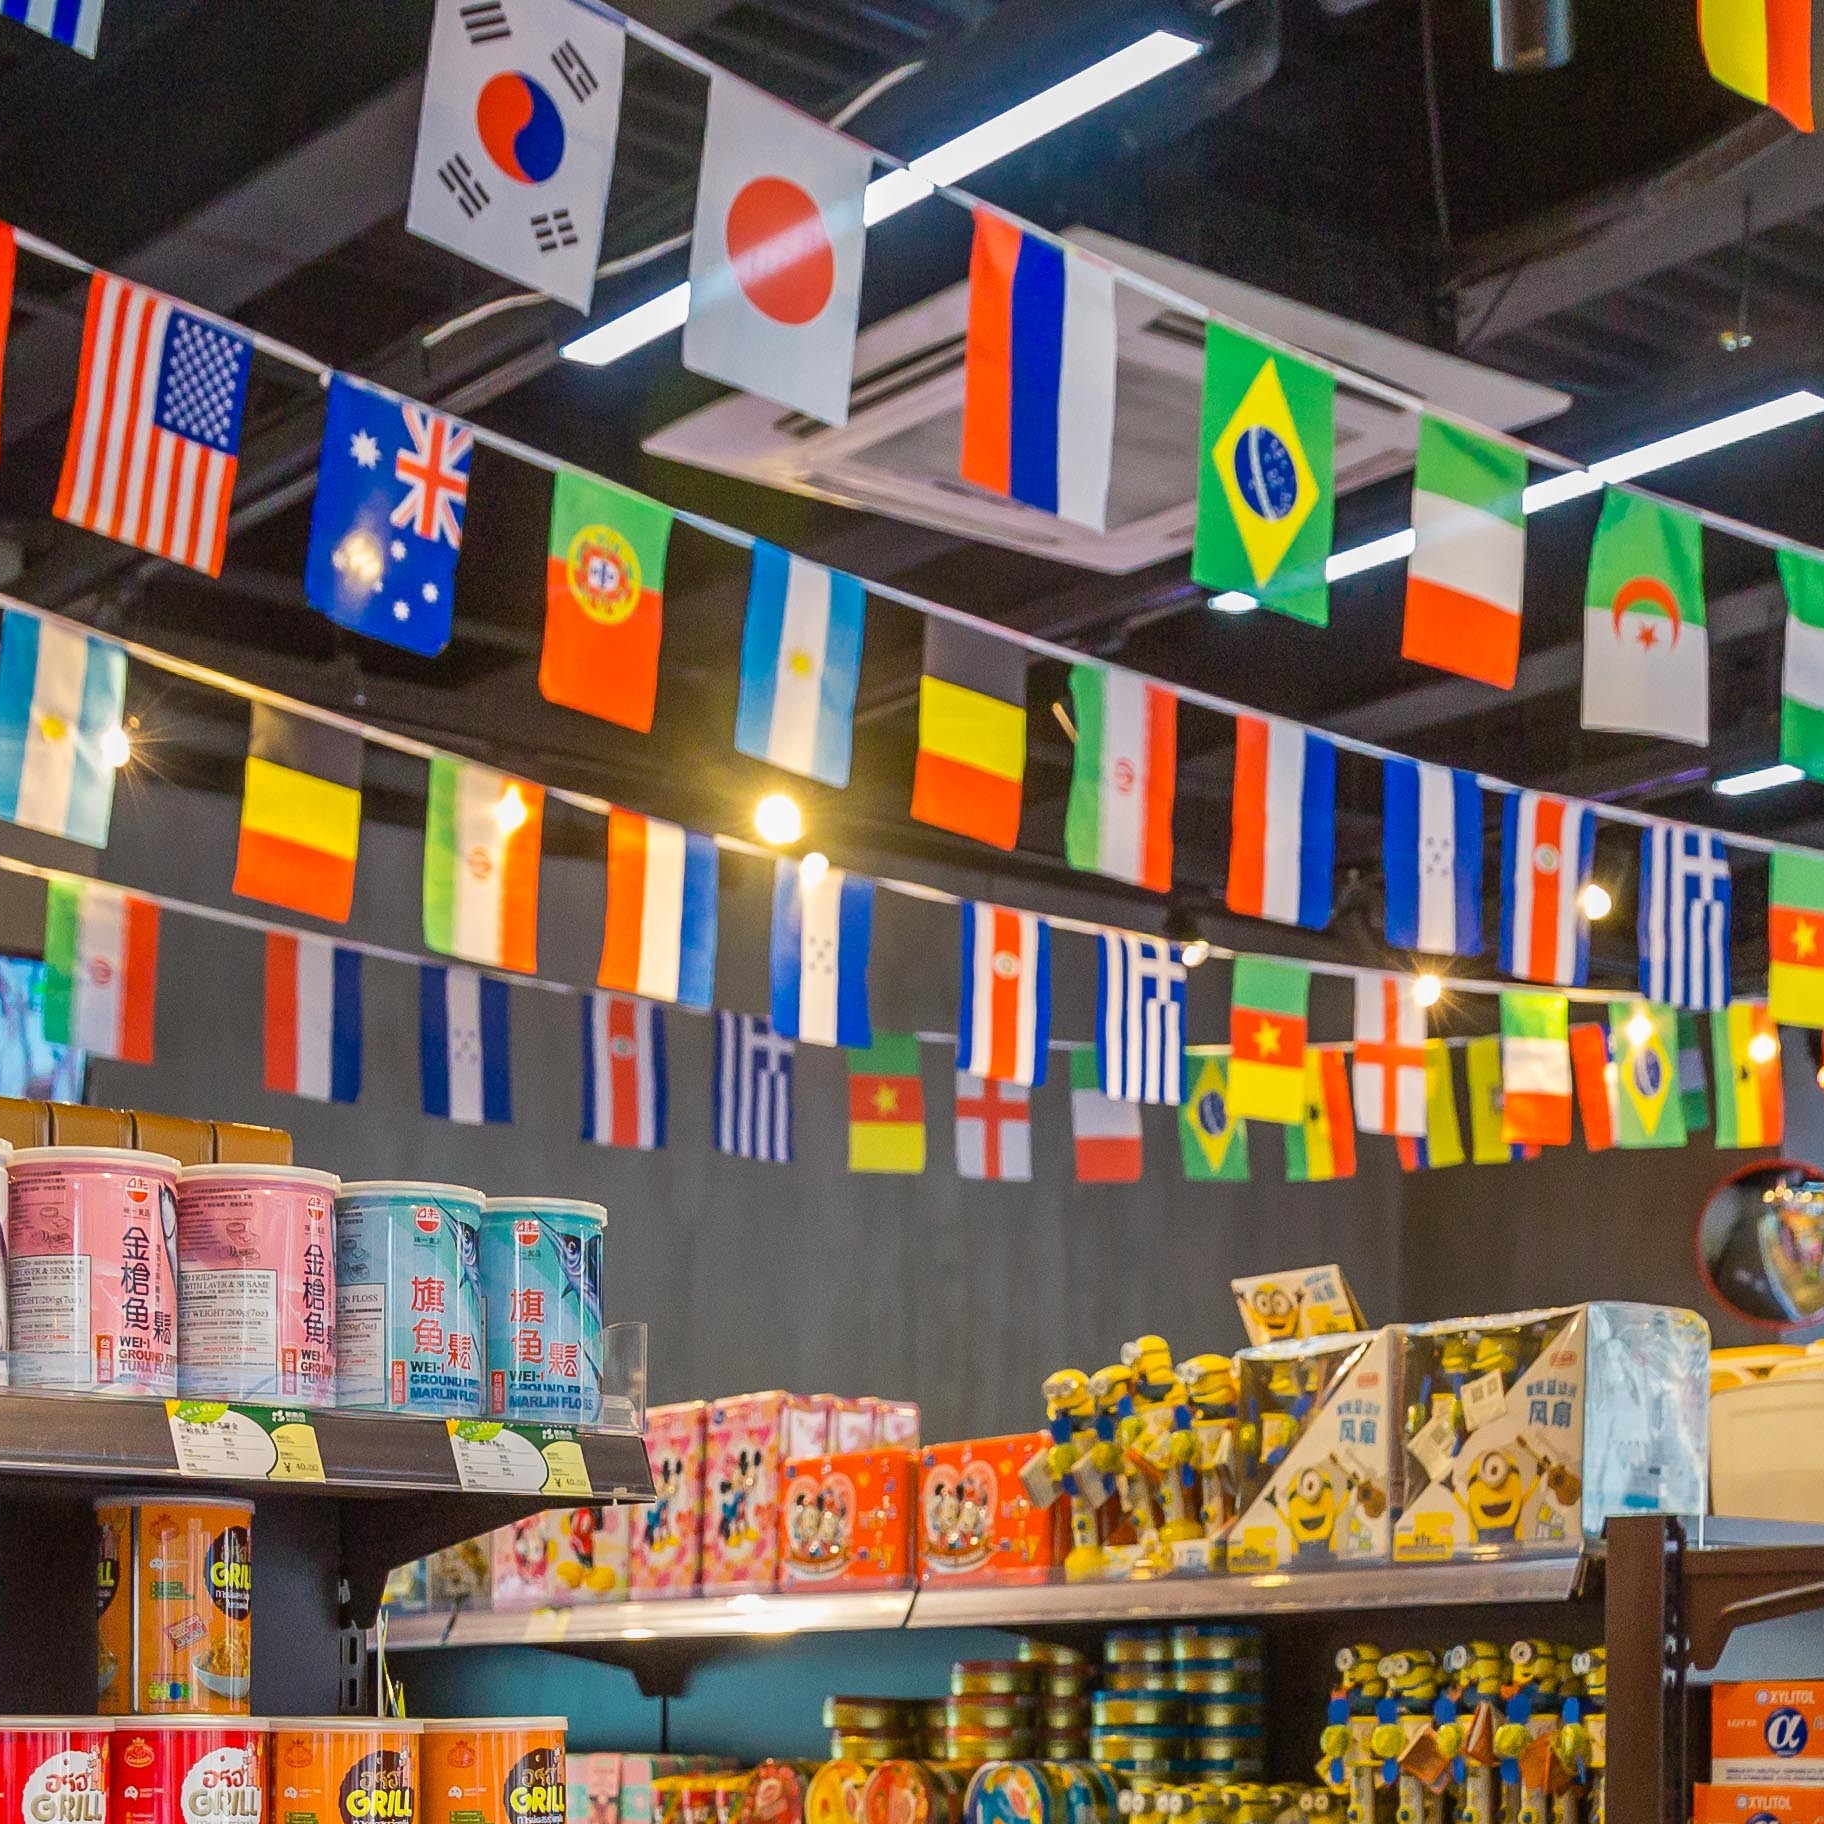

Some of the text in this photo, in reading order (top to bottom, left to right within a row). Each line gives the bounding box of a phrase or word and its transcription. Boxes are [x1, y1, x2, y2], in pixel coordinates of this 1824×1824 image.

[121, 1227, 150, 1331] 金槍魚
[302, 1244, 325, 1343] 金槍魚
[411, 1275, 445, 1355] 旗魚
[509, 1288, 544, 1364] 旗魚
[119, 1360, 151, 1373] TUNA
[410, 1373, 461, 1386] GROUND
[410, 1388, 458, 1400] MARLIN
[509, 1396, 559, 1409] MARLIN
[296, 1463, 319, 1472] 40.00
[1770, 1689, 1816, 1705] XYLITOL
[30, 1793, 102, 1823] GRILL
[187, 1787, 260, 1818] GRILL
[346, 1788, 412, 1817] GRILL
[510, 1784, 565, 1813] GRILL
